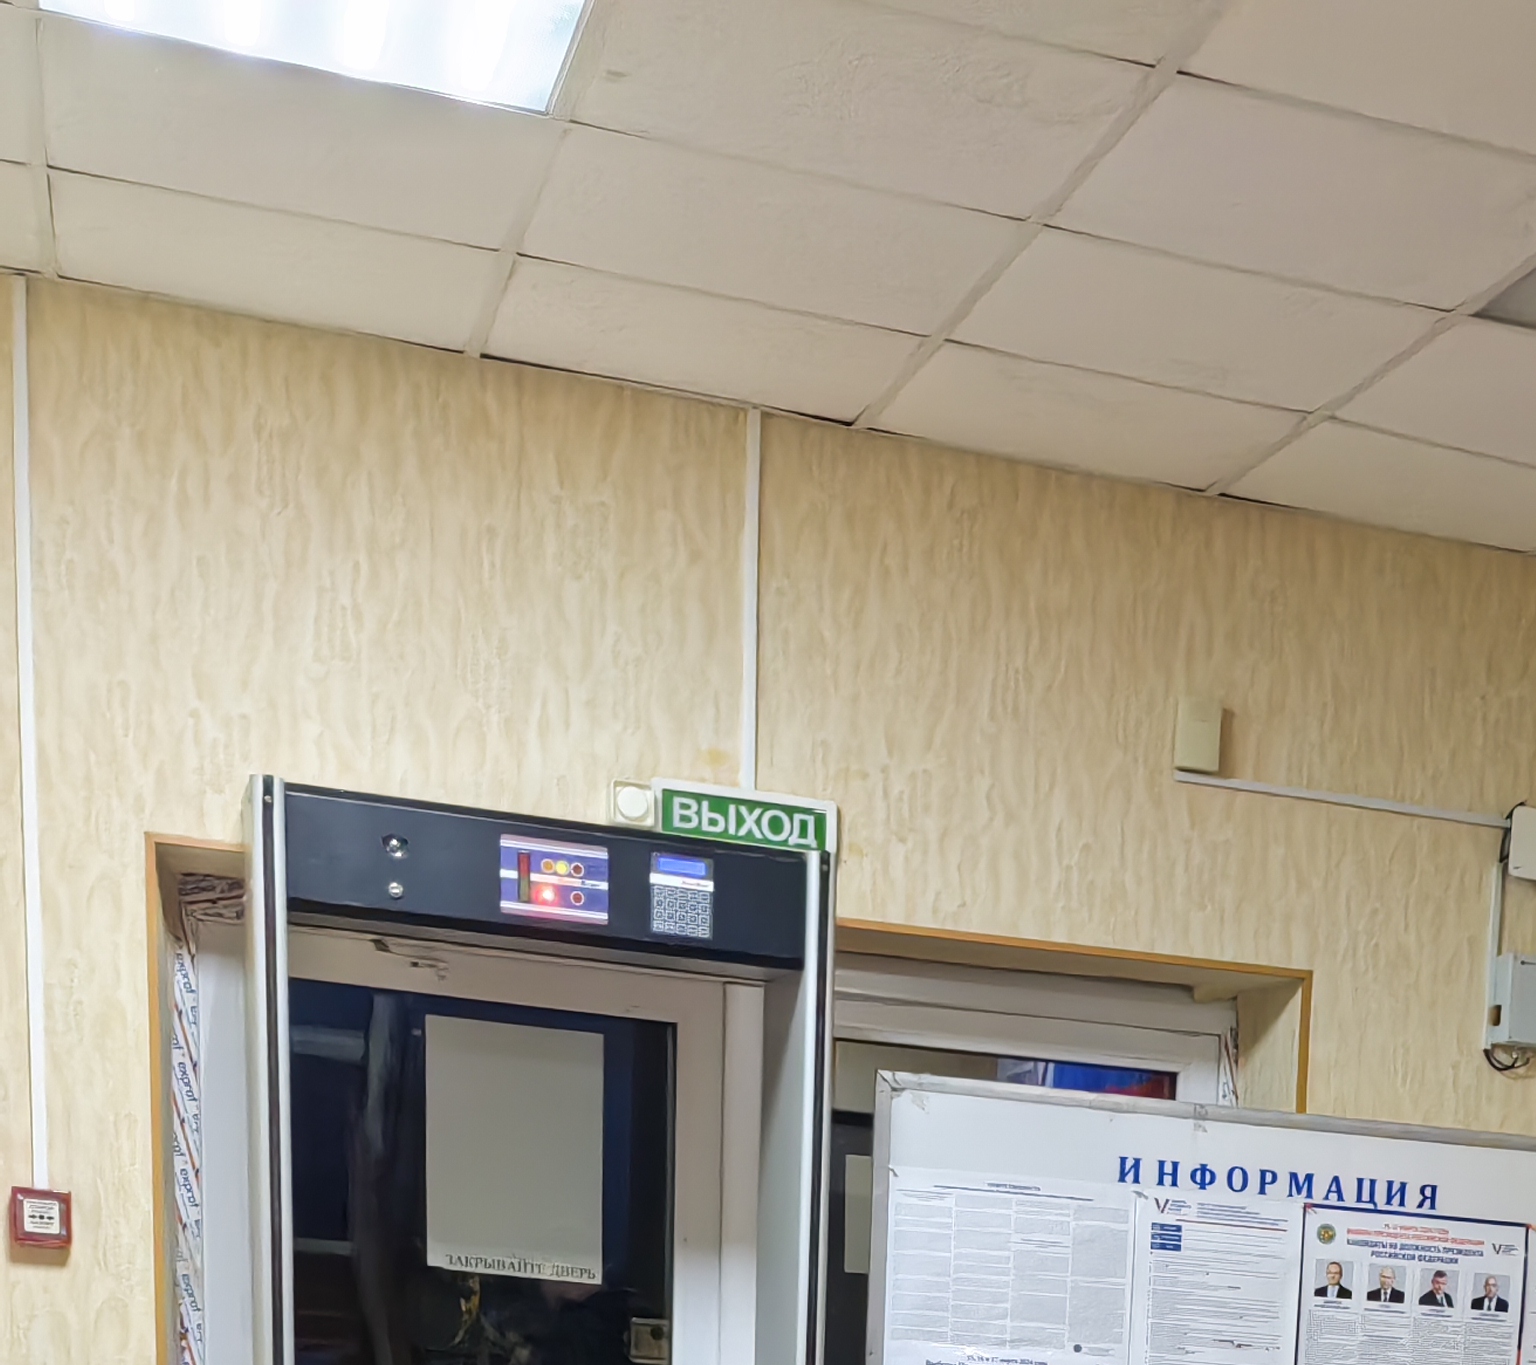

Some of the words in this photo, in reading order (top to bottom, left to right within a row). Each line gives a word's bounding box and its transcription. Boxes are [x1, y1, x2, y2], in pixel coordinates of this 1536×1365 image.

[670, 797, 820, 850] ВЫХОД
[1117, 1155, 1441, 1212] ИНФОРМАЦИЯ
[549, 1261, 597, 1280] ДВЕРЬ
